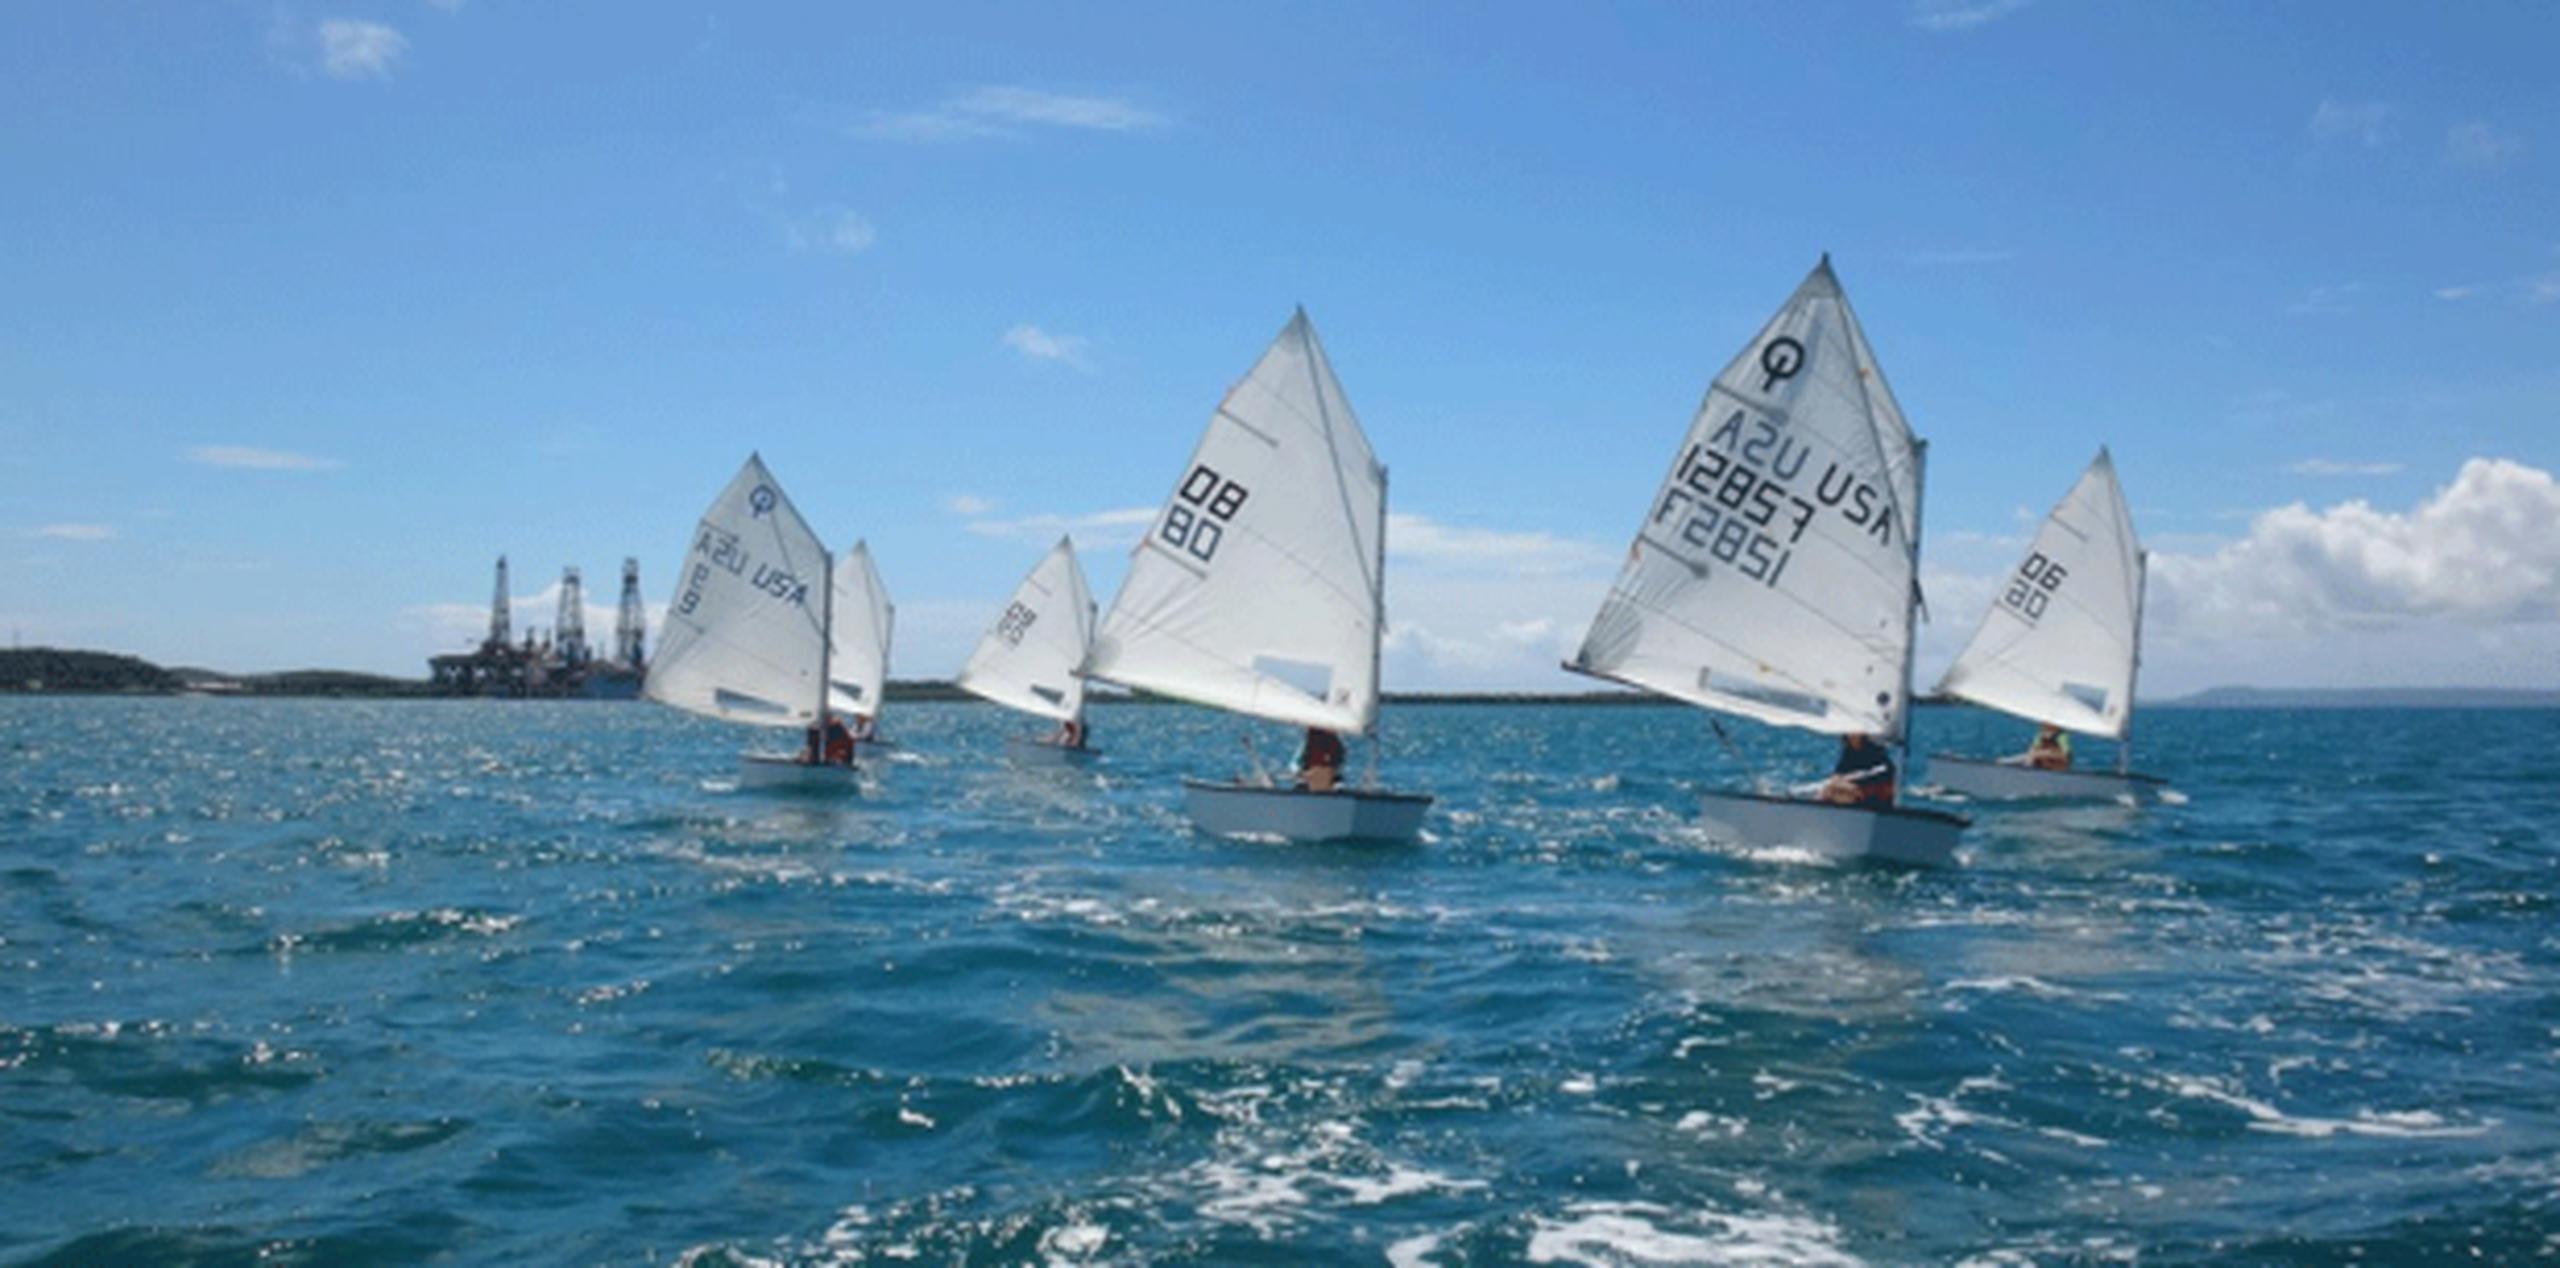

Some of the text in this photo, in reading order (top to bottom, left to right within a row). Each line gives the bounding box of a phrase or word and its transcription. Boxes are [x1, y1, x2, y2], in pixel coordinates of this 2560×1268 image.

[1180, 465, 1248, 522] 08
[1676, 443, 1815, 544] 12857
[1816, 462, 1892, 546] USA
[752, 562, 808, 606] USA
[2020, 552, 2068, 591] 06
